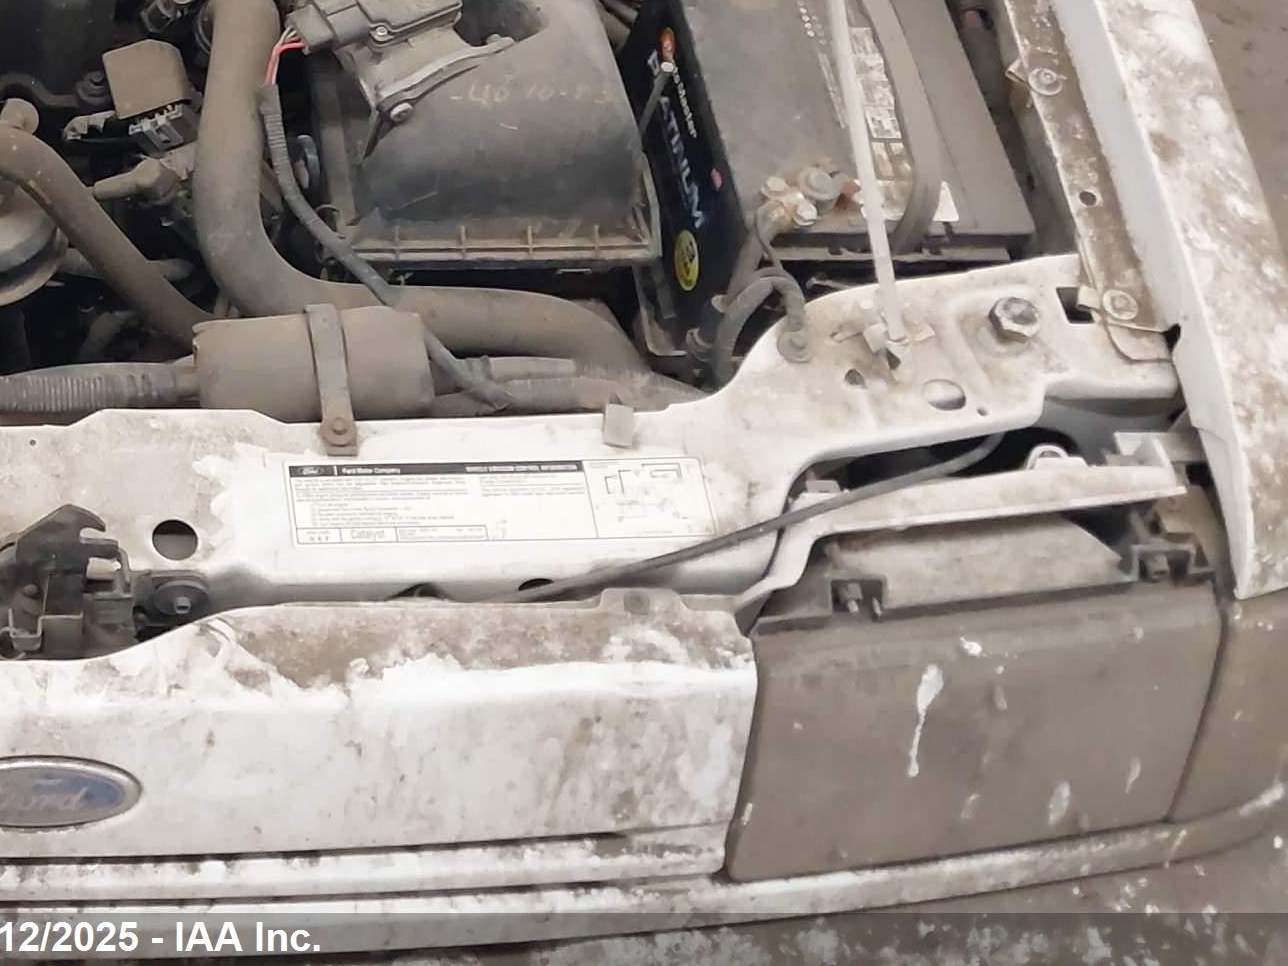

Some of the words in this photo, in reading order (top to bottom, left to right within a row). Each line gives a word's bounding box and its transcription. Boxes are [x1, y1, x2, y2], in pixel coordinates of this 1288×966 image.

[648, 48, 706, 228] PATINUM
[374, 467, 401, 475] Company
[351, 530, 385, 541] Catalyst
